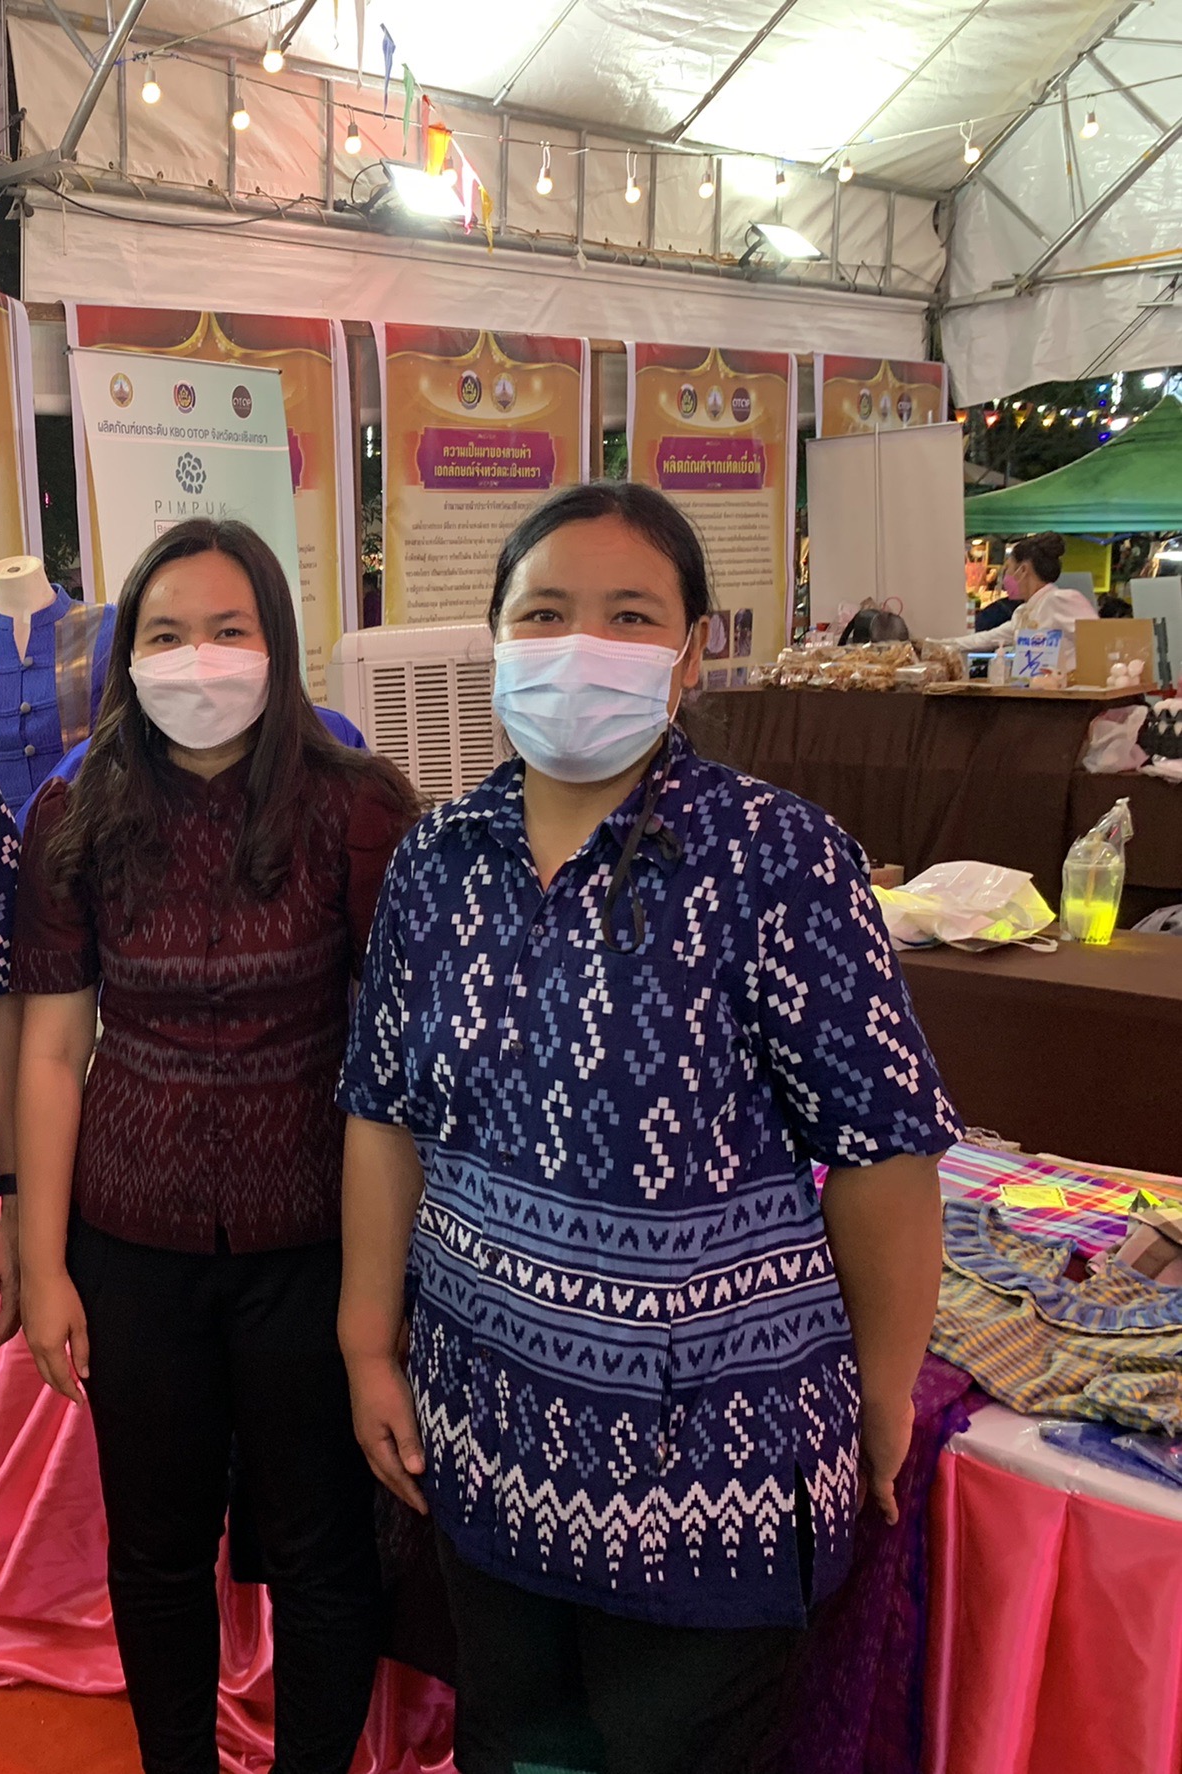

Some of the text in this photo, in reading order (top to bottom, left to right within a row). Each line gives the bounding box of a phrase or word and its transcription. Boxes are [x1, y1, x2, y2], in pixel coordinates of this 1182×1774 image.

[98, 421, 268, 444] ผลิตภัณฑ์ยกระดับ KBO OTOP จังหวัดฉะเชิงเทรา
[443, 441, 532, 459] ความเป็นมาของลายผ้า
[434, 461, 541, 478] เอกลักษณ์จังหวัดฉะเชิงเทรา
[154, 500, 227, 515] PIMPUK
